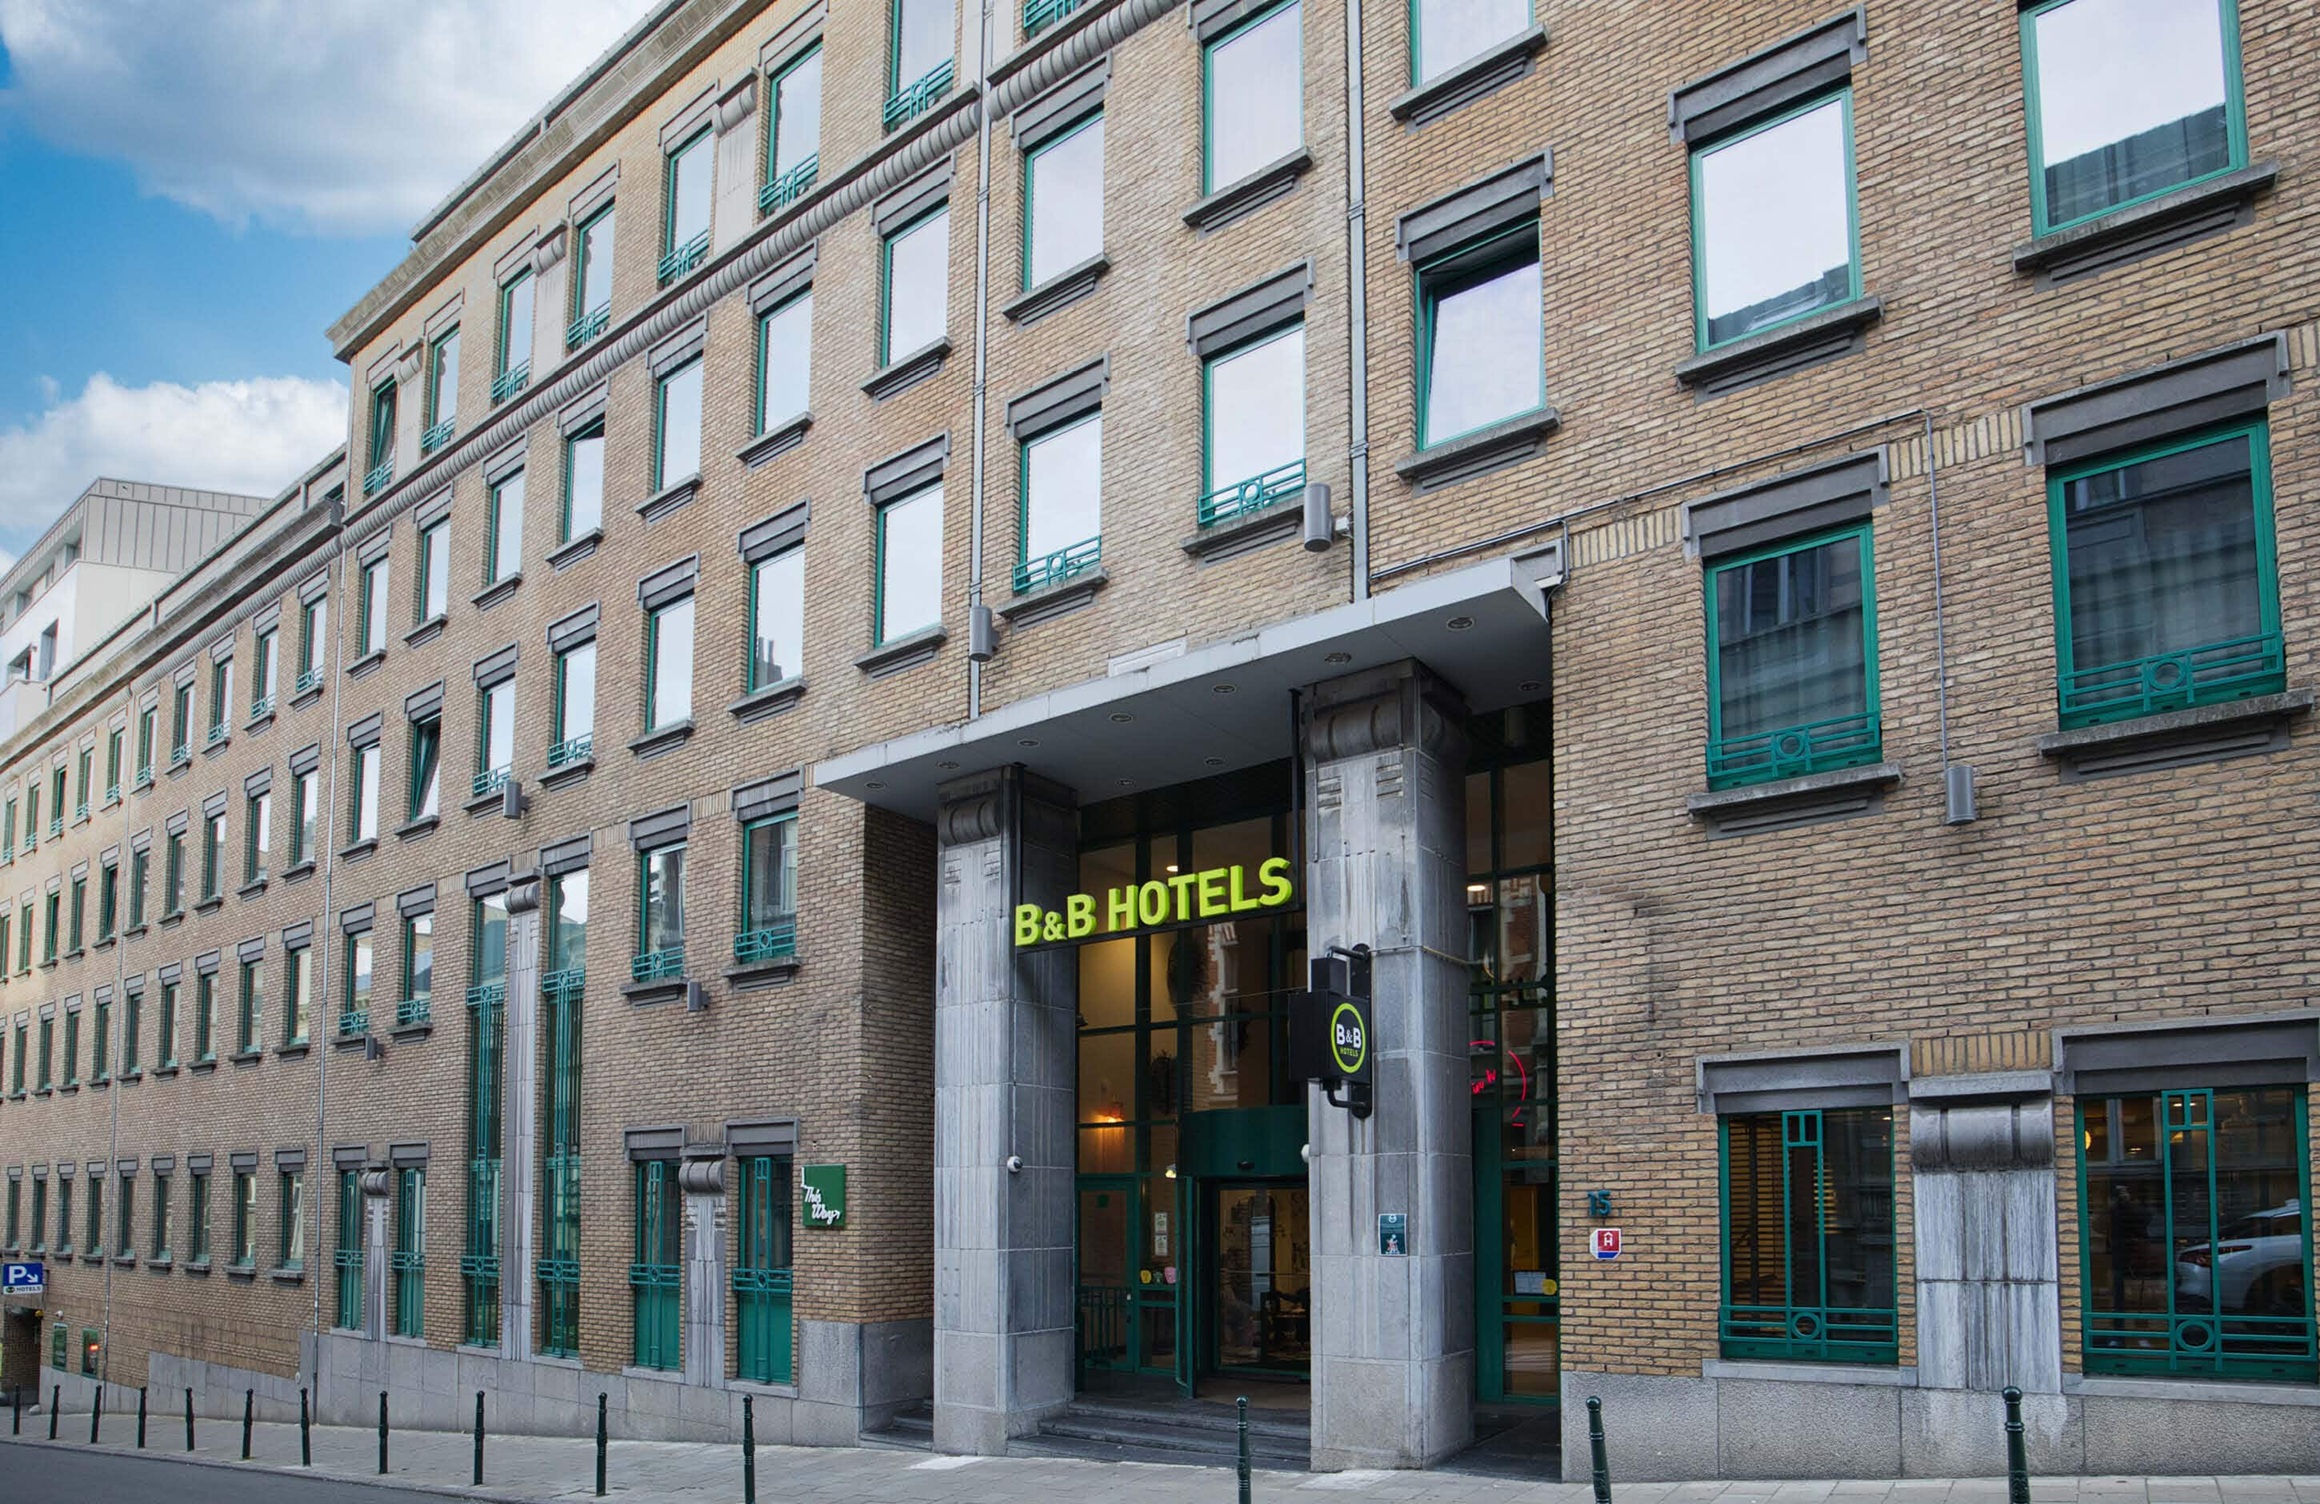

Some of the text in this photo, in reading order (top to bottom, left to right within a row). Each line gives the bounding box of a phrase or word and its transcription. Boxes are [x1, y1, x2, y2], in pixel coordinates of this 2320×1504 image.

[1015, 857, 1293, 947] B&B HOTELS
[1336, 1023, 1361, 1048] B&B
[1340, 1046, 1359, 1057] HOTELS
[803, 1185, 822, 1203] This
[1587, 1190, 1611, 1216] 15
[812, 1203, 837, 1225] Way
[8, 1265, 27, 1284] P
